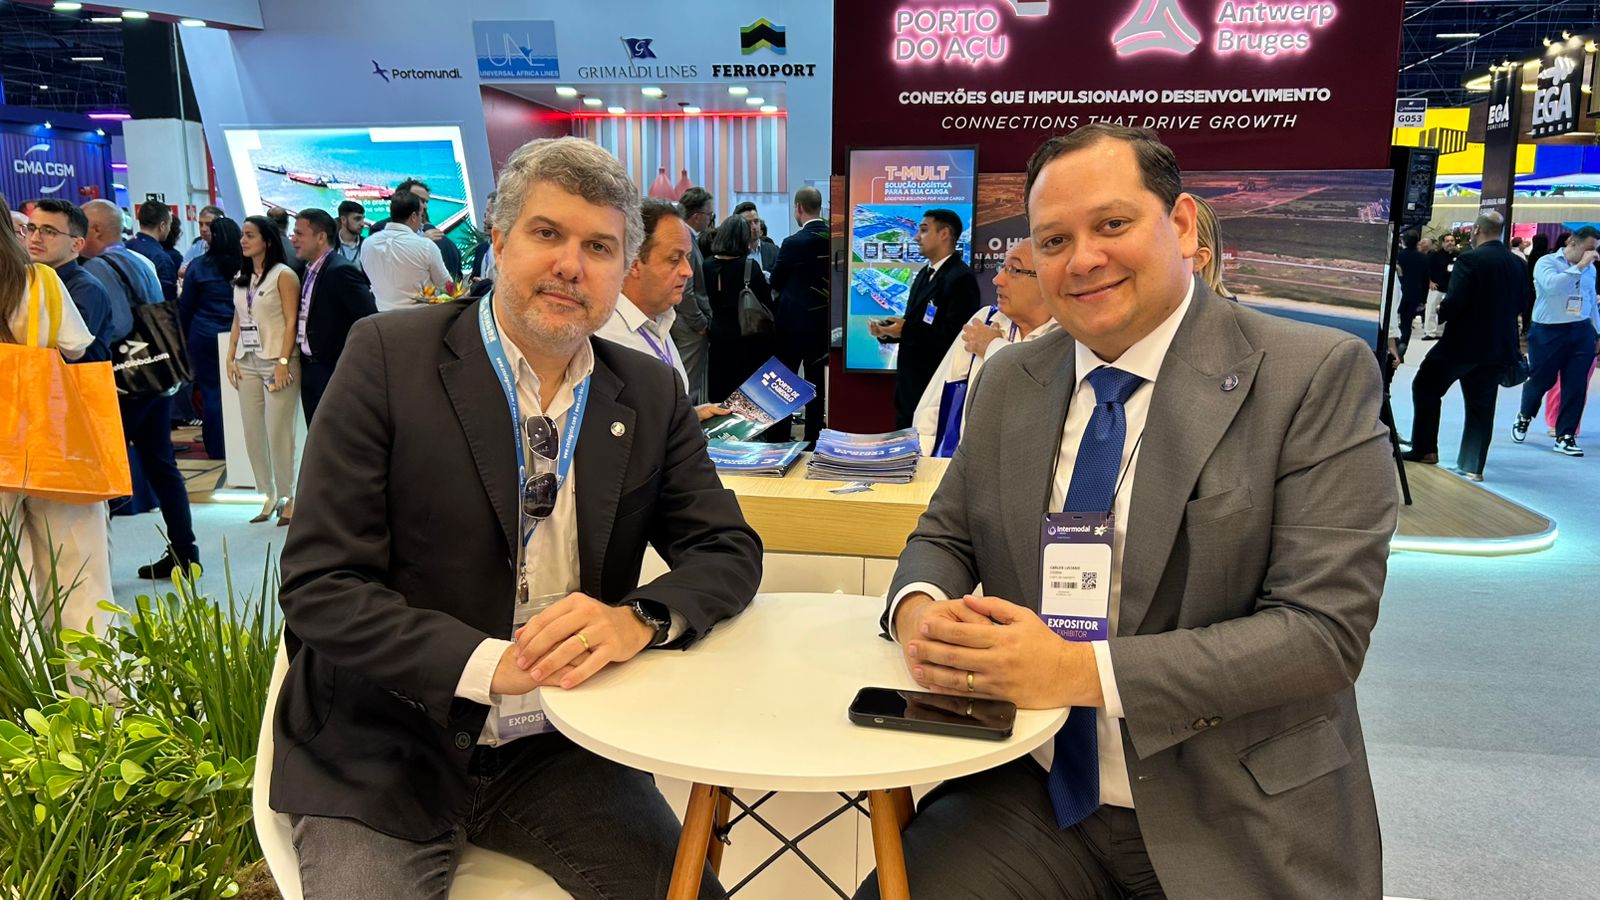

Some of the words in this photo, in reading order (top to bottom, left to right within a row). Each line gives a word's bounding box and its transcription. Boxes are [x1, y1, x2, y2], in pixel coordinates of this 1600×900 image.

[896, 10, 998, 32] PORTO
[1218, 2, 1334, 26] Antwerp
[895, 37, 938, 60] DO
[944, 36, 1006, 64] AÇU
[1217, 30, 1310, 56] Bruges
[578, 66, 652, 78] GRIMALDI
[656, 65, 698, 78] LINES
[712, 64, 816, 78] FERROPORT
[899, 88, 986, 104] CONEXÕES
[990, 90, 1025, 104] QUE
[1162, 88, 1330, 103] DESENVOLVIMENTO
[1532, 82, 1572, 125] EGA
[1398, 114, 1422, 122] G053
[1488, 98, 1510, 124] EGA
[942, 116, 1079, 130] CONNECTIONS
[1143, 116, 1202, 129] DRIVE
[1209, 114, 1298, 129] GROWTH
[14, 160, 44, 174] CMA
[46, 162, 74, 177] CGM
[884, 166, 950, 180] T-MULT
[885, 181, 916, 189] SOLUÇÃO
[1048, 618, 1098, 630] EXPOSITOR
[1057, 629, 1088, 638] EXHIBITOR
[509, 712, 544, 727] EXPOSI
